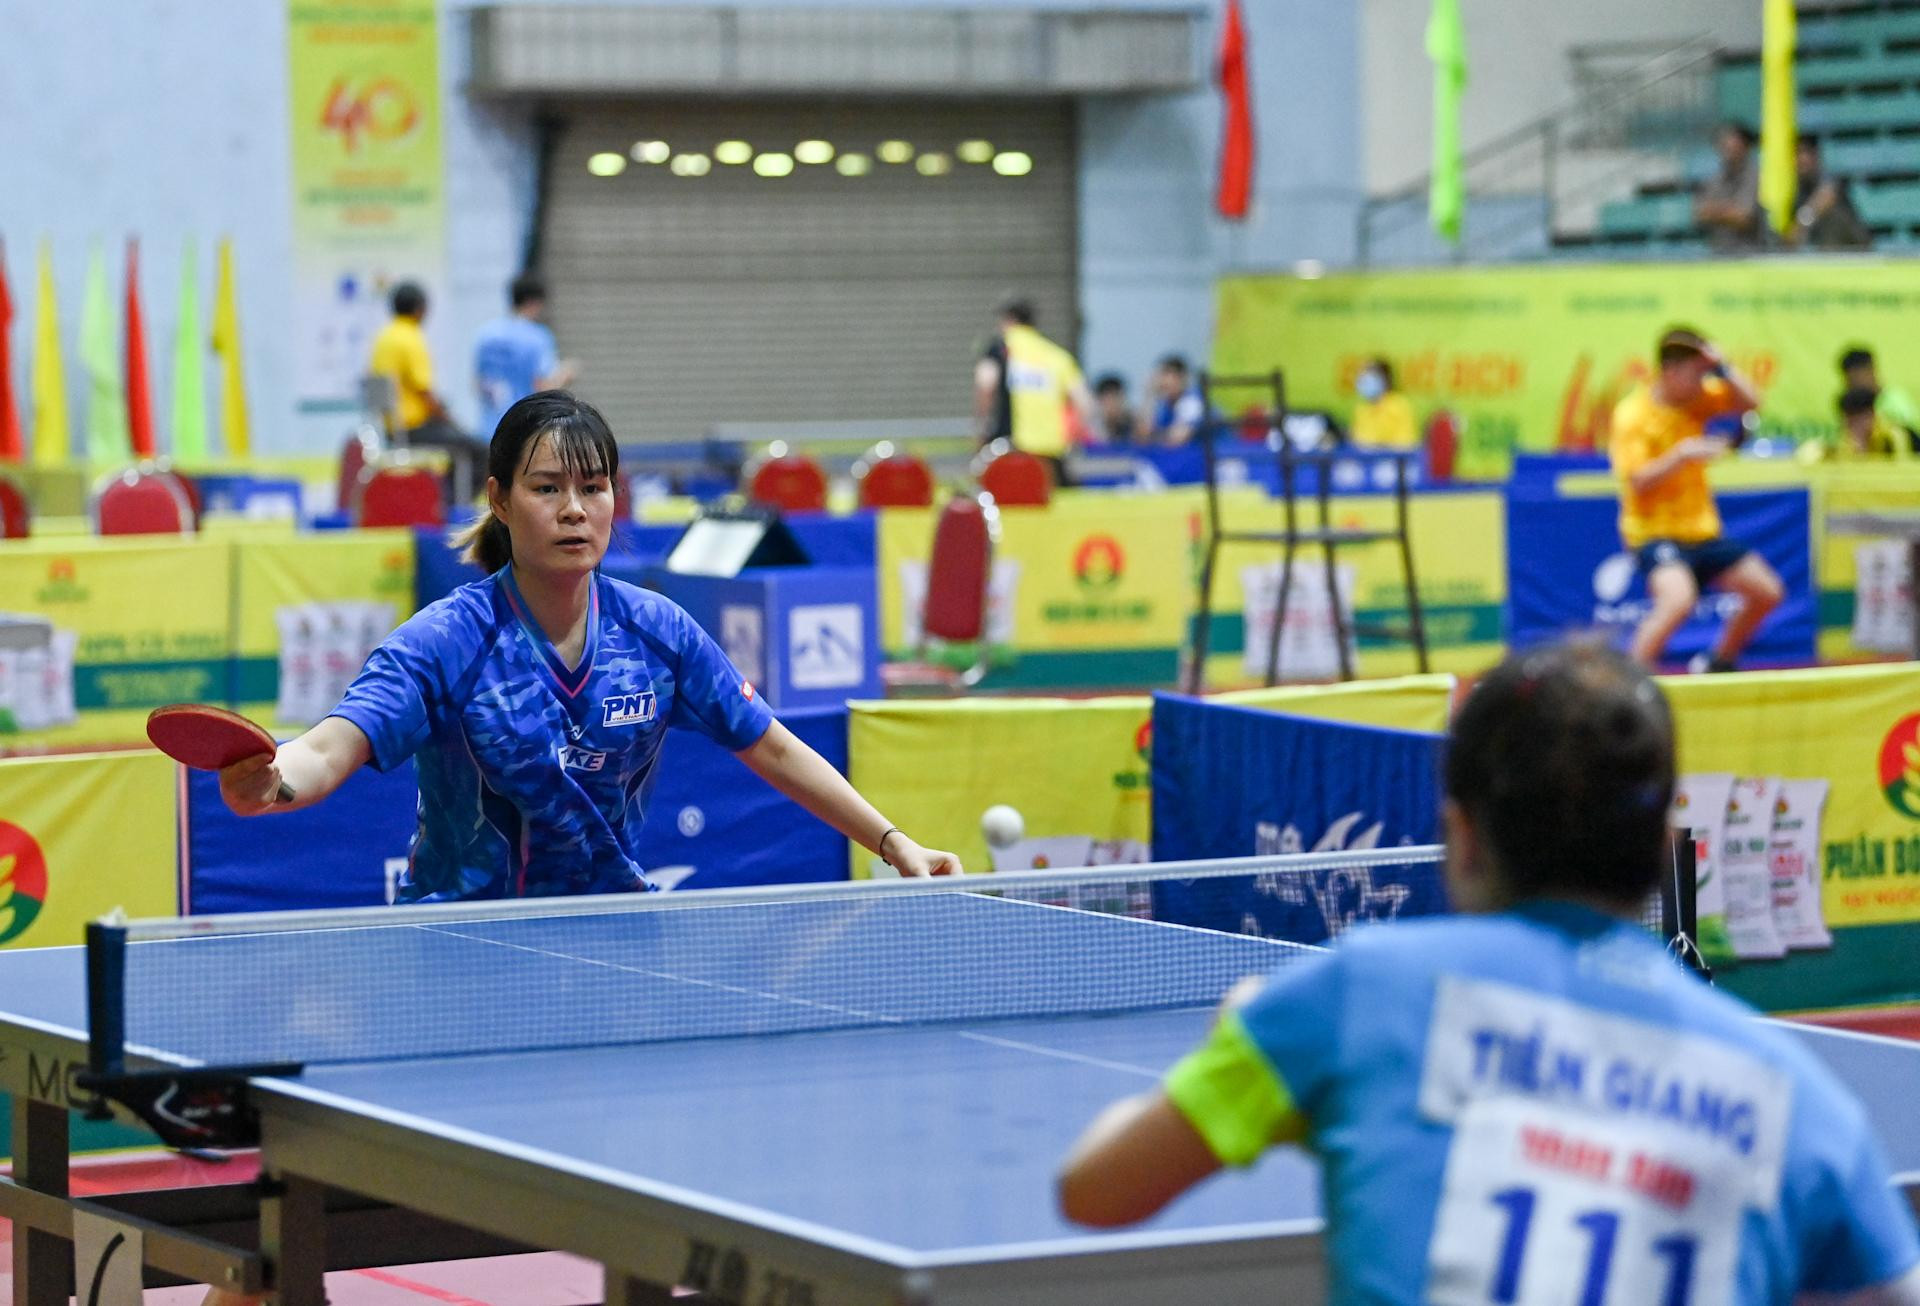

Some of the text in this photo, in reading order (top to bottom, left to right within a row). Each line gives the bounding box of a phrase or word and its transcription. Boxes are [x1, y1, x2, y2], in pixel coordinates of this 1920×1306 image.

[604, 694, 653, 722] PNT
[1604, 1053, 1757, 1155] GIANG
[1493, 1188, 1700, 1306] 111
